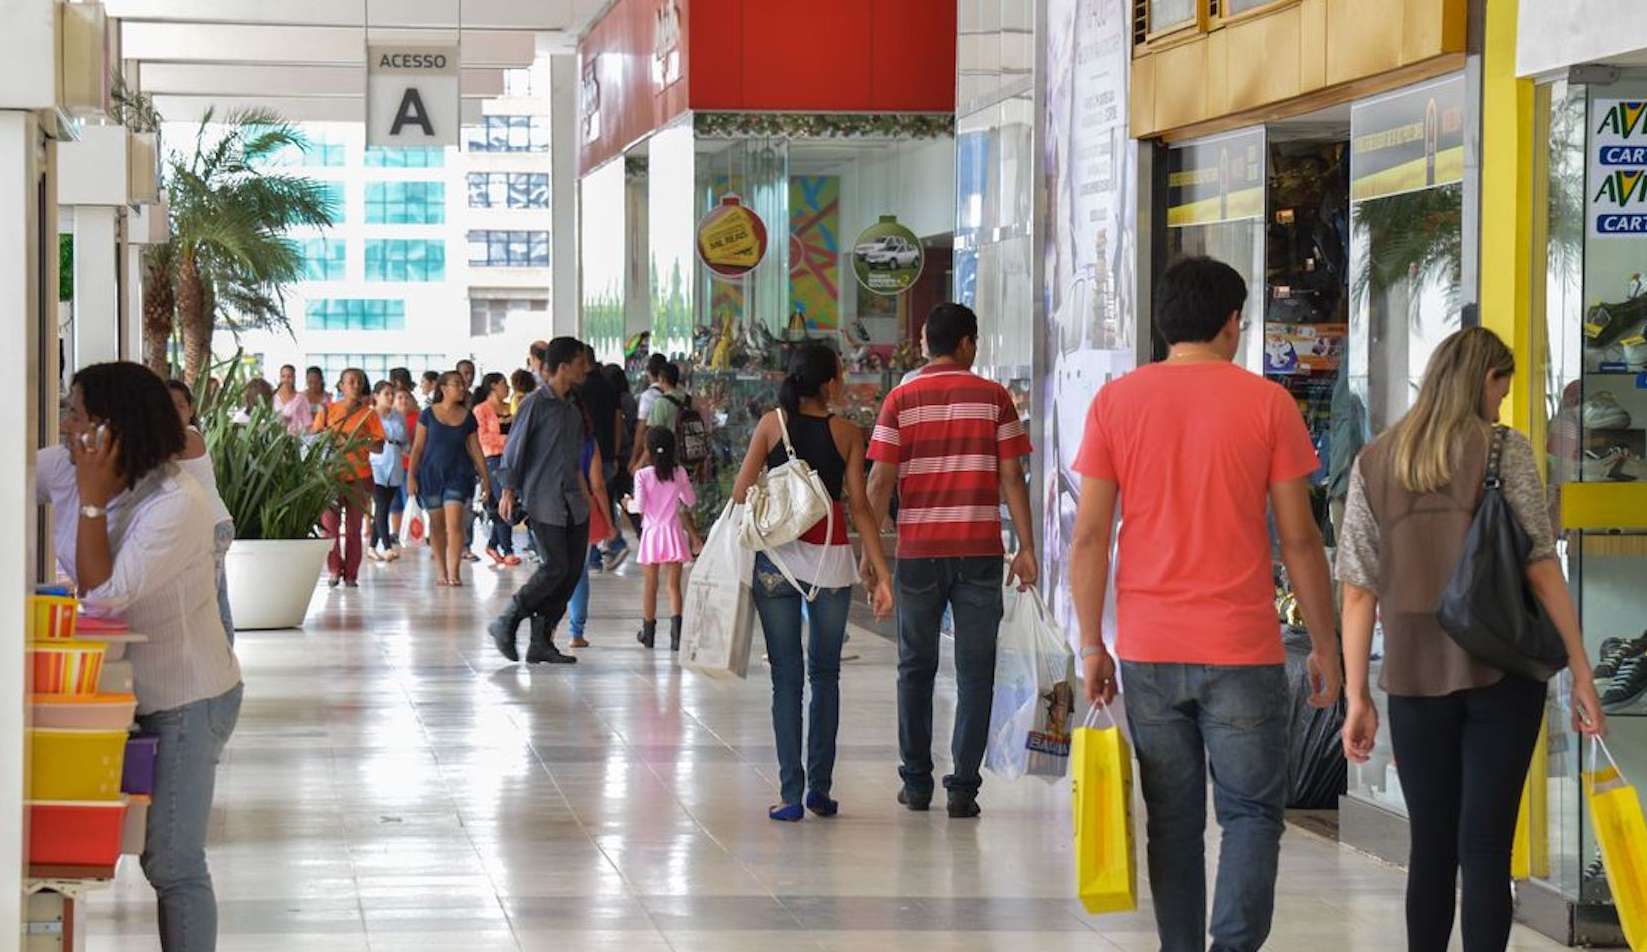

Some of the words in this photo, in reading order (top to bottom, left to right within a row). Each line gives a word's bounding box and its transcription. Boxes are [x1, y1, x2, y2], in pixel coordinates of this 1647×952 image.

[379, 54, 447, 68] ACESSO
[389, 88, 435, 136] A
[1607, 148, 1647, 163] CAR
